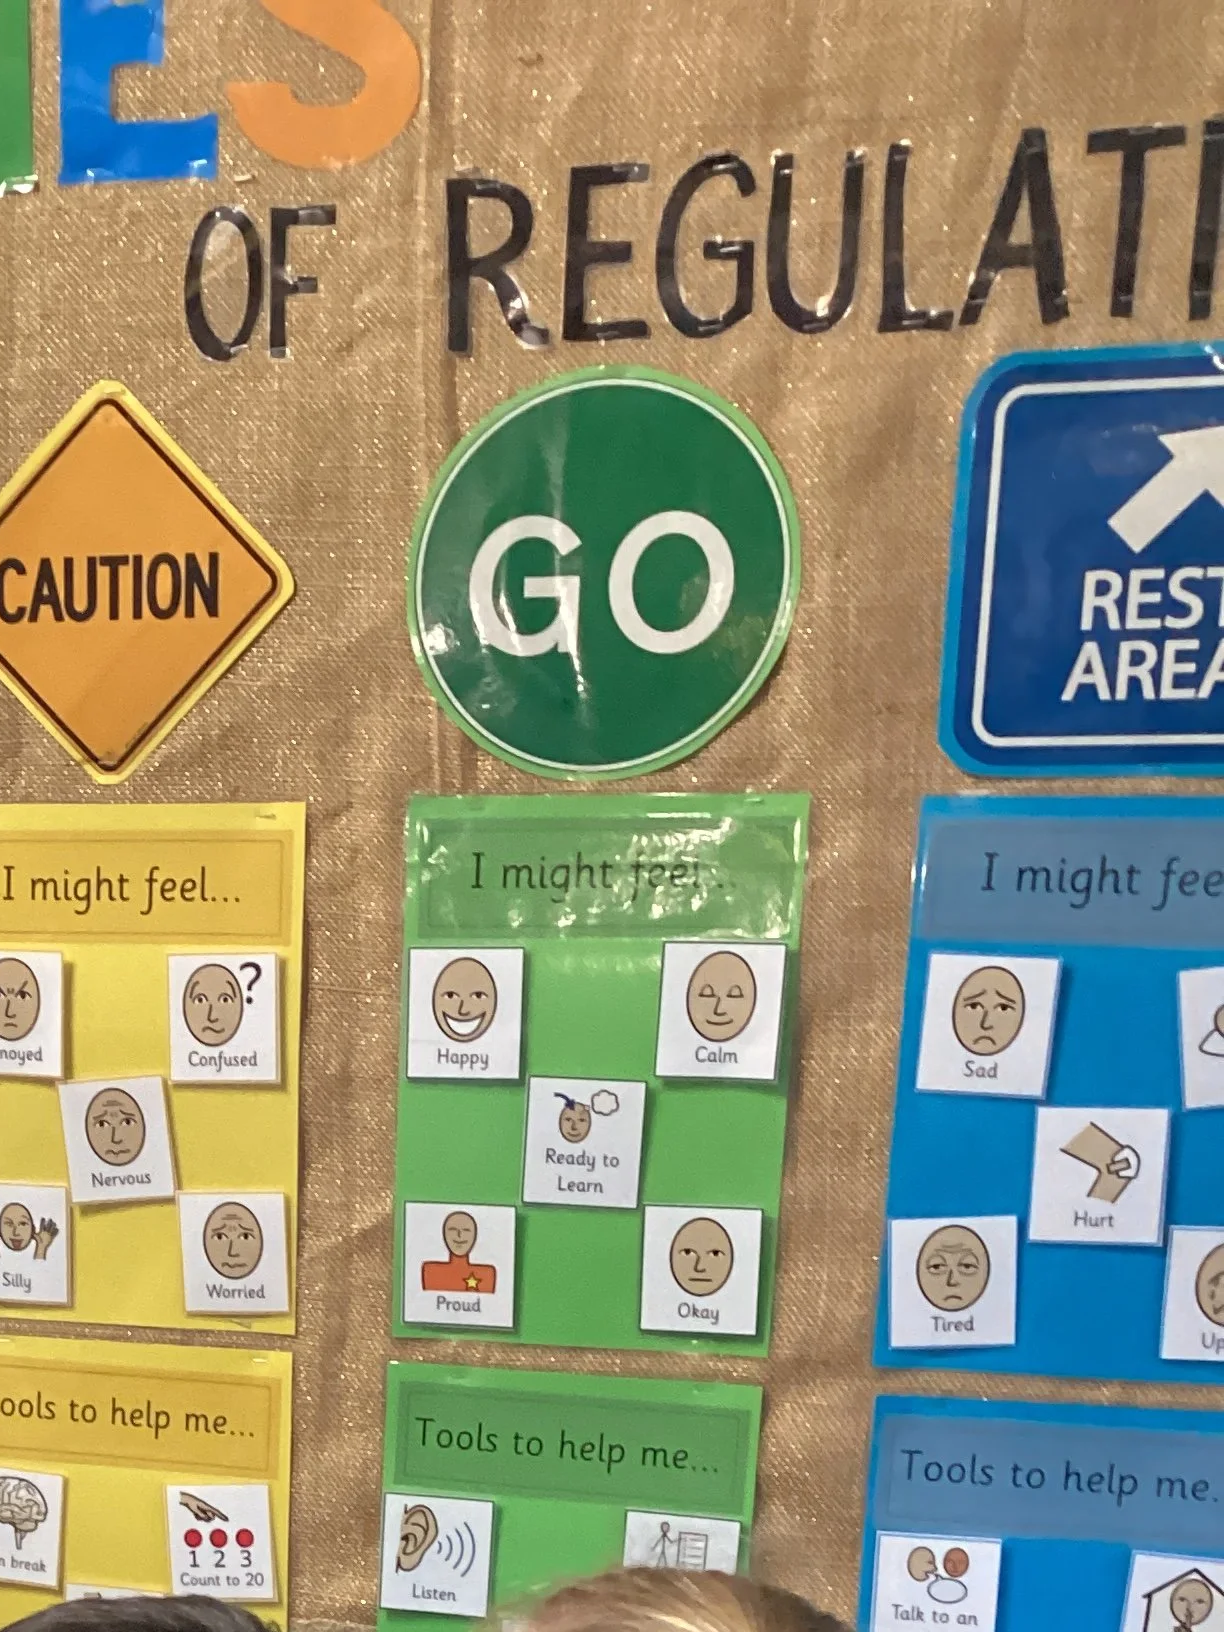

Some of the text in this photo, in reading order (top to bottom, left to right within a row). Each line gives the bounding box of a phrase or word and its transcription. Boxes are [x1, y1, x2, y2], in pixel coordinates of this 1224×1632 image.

[445, 119, 1224, 353] REGULATI
[184, 204, 337, 361] OF
[469, 509, 736, 657] GO
[471, 850, 736, 904] I might feel..
[981, 851, 1224, 911] I might fee
[2, 865, 241, 915] I might feel...
[187, 1049, 258, 1071] Confused
[436, 1048, 490, 1070] Happy
[694, 1046, 738, 1064] Calm
[962, 1060, 999, 1079] Sad
[544, 1147, 620, 1172] Ready to
[91, 1171, 152, 1188] Nervous
[557, 1175, 604, 1194] Learn
[1073, 1210, 1114, 1230] Hurt
[1, 1271, 32, 1293] Silly
[205, 1283, 265, 1300] Worried
[436, 1296, 482, 1314] Proud
[677, 1302, 720, 1324] Okay
[931, 1316, 975, 1334] Tired
[69, 1400, 97, 1423] to
[111, 1397, 171, 1439] help
[184, 1411, 255, 1438] me...
[415, 1416, 720, 1475] Tools to help me...
[901, 1448, 994, 1488] Tools
[1011, 1463, 1045, 1491] to
[1063, 1460, 1139, 1508] help
[11, 1556, 47, 1573] break
[189, 1551, 252, 1568] 1 2 3
[180, 1572, 265, 1587] Count to 20
[412, 1583, 457, 1603] Listen
[891, 1603, 979, 1627] Talk to an
